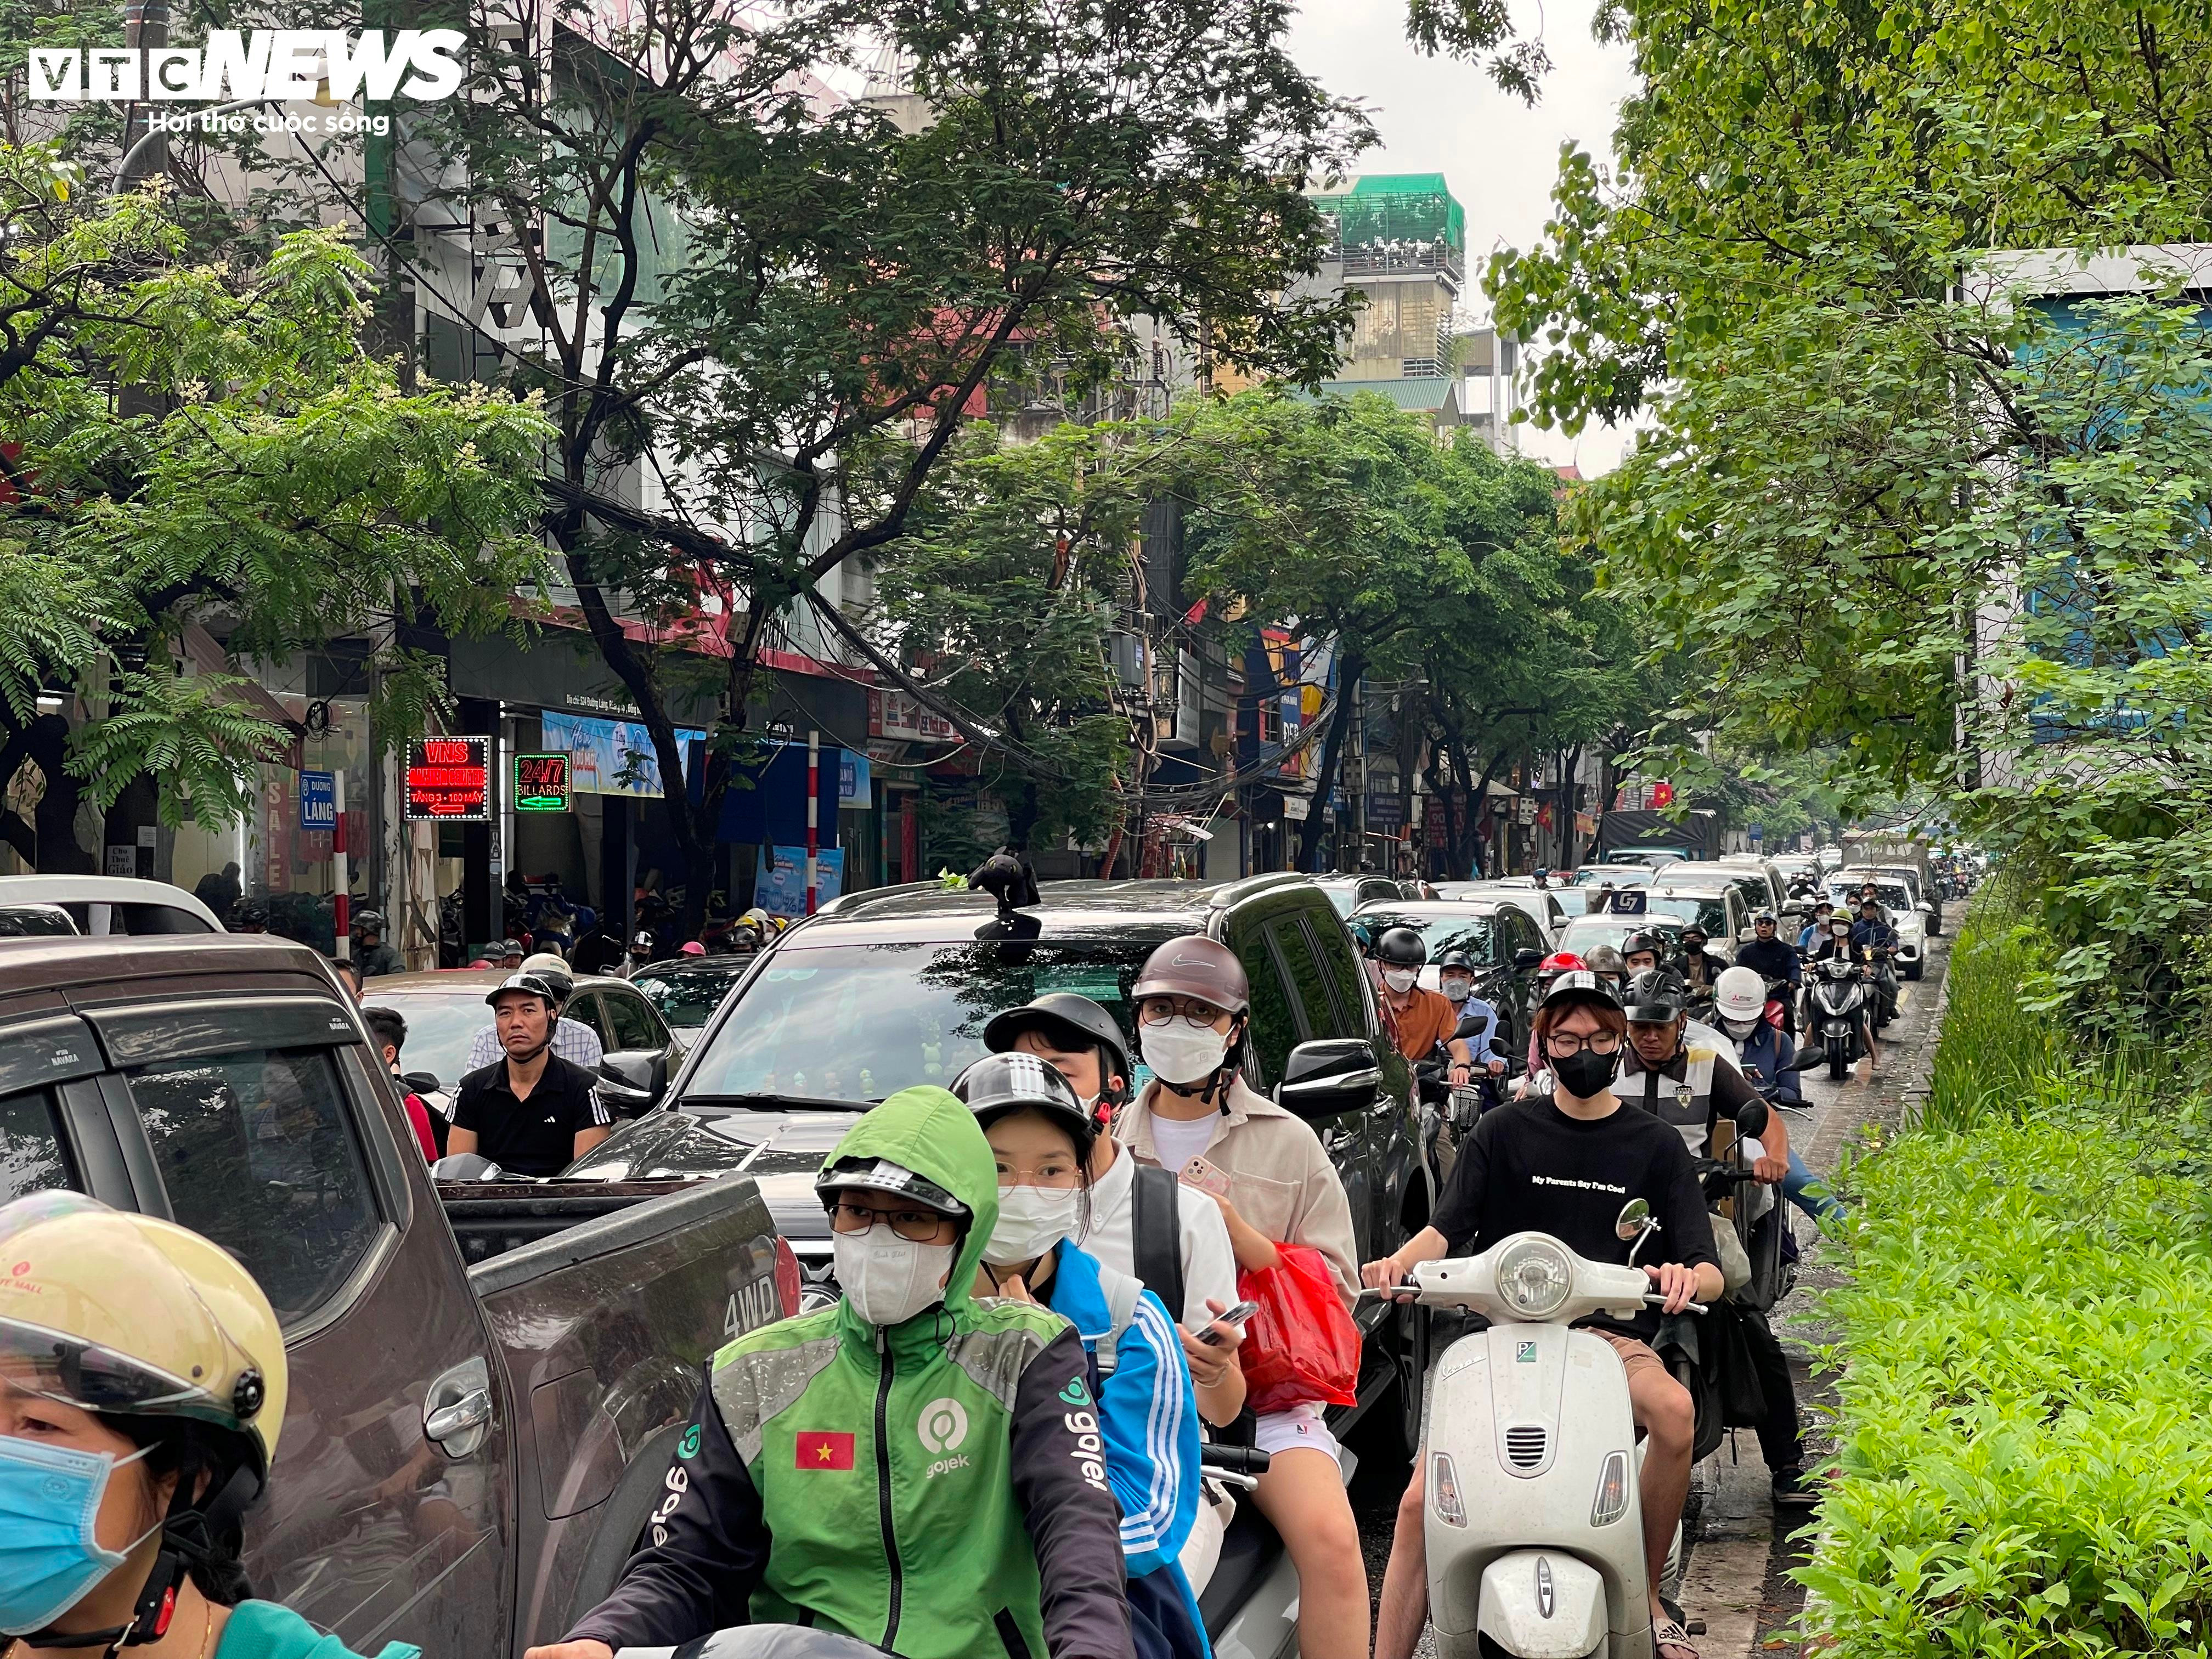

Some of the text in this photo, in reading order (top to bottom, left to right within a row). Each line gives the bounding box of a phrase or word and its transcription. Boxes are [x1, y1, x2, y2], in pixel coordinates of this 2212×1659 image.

[426, 743, 468, 763] VNS
[520, 760, 564, 782] 24/7
[436, 793, 442, 802] 3
[449, 793, 462, 802] 100
[517, 785, 566, 795] BILLARDS
[304, 797, 334, 821] LÁNG
[108, 864, 133, 874] Giáo
[1620, 893, 1638, 911] G7
[51, 1053, 80, 1066] NAVARA
[1532, 1176, 1626, 1194] My Parents Say I'm Cool
[724, 1276, 774, 1338] 4WD
[926, 1454, 970, 1479] gojek
